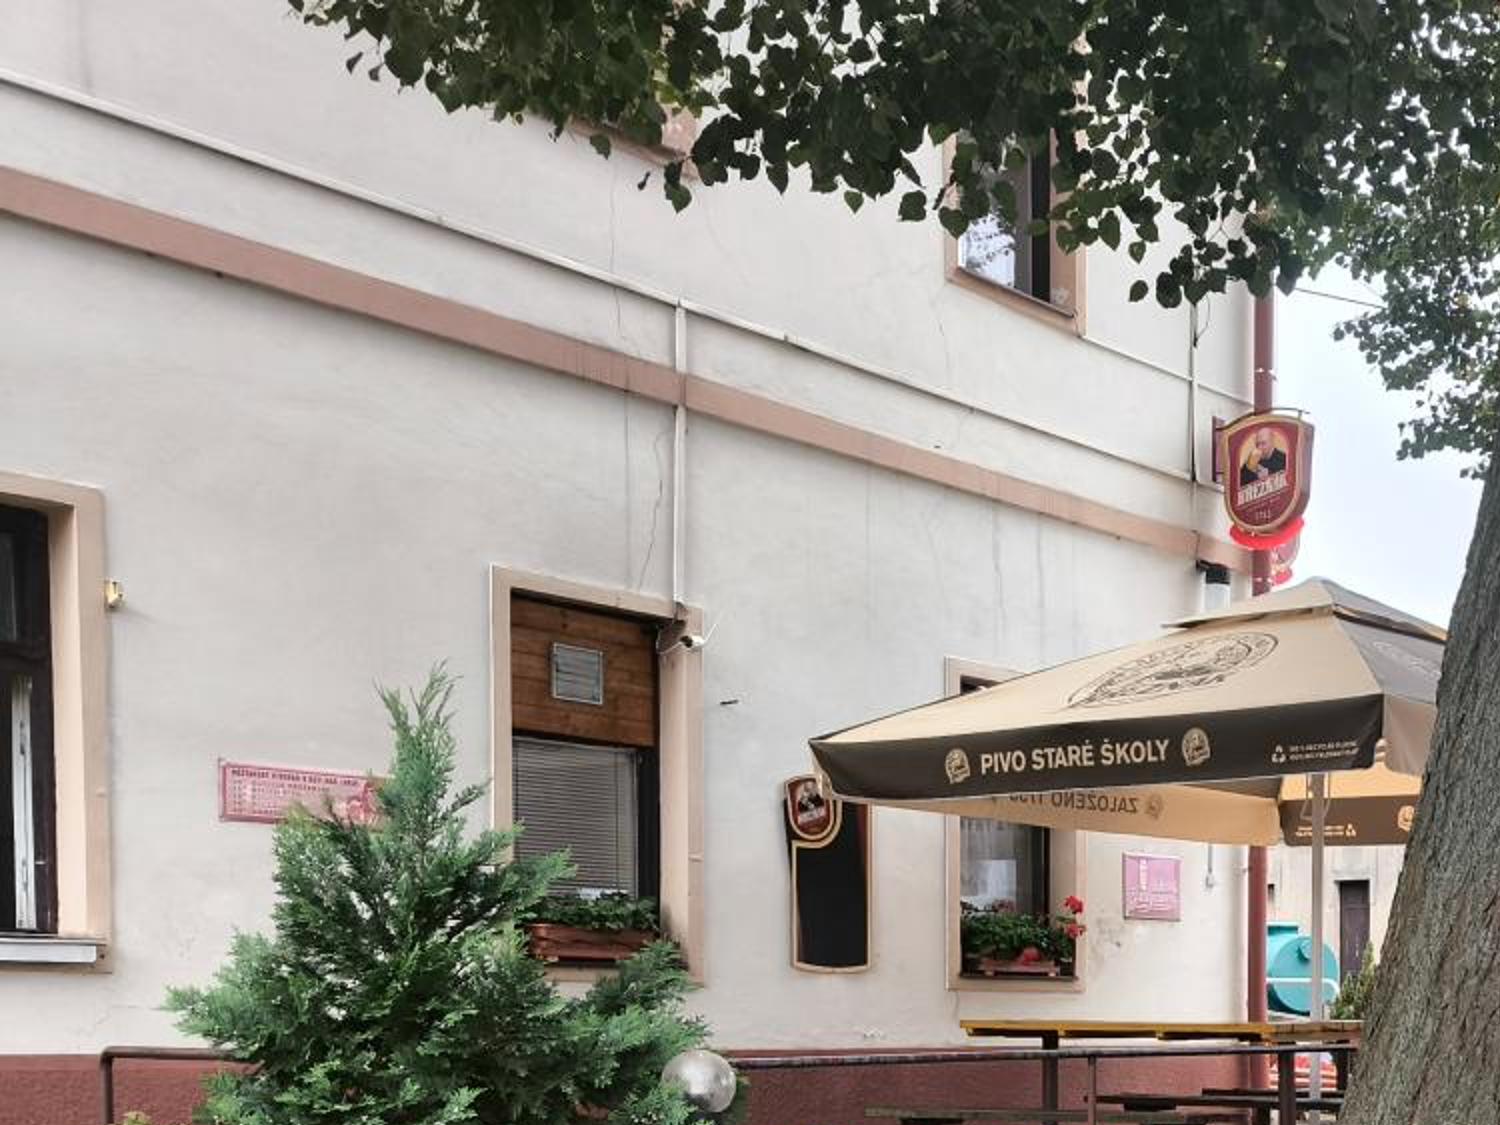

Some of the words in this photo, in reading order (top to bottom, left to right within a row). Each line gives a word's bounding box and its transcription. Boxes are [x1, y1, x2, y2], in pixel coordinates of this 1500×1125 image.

[981, 751, 1026, 775] PIVO
[1031, 740, 1094, 770] STARÉ
[1101, 738, 1170, 765] ŠKOLY
